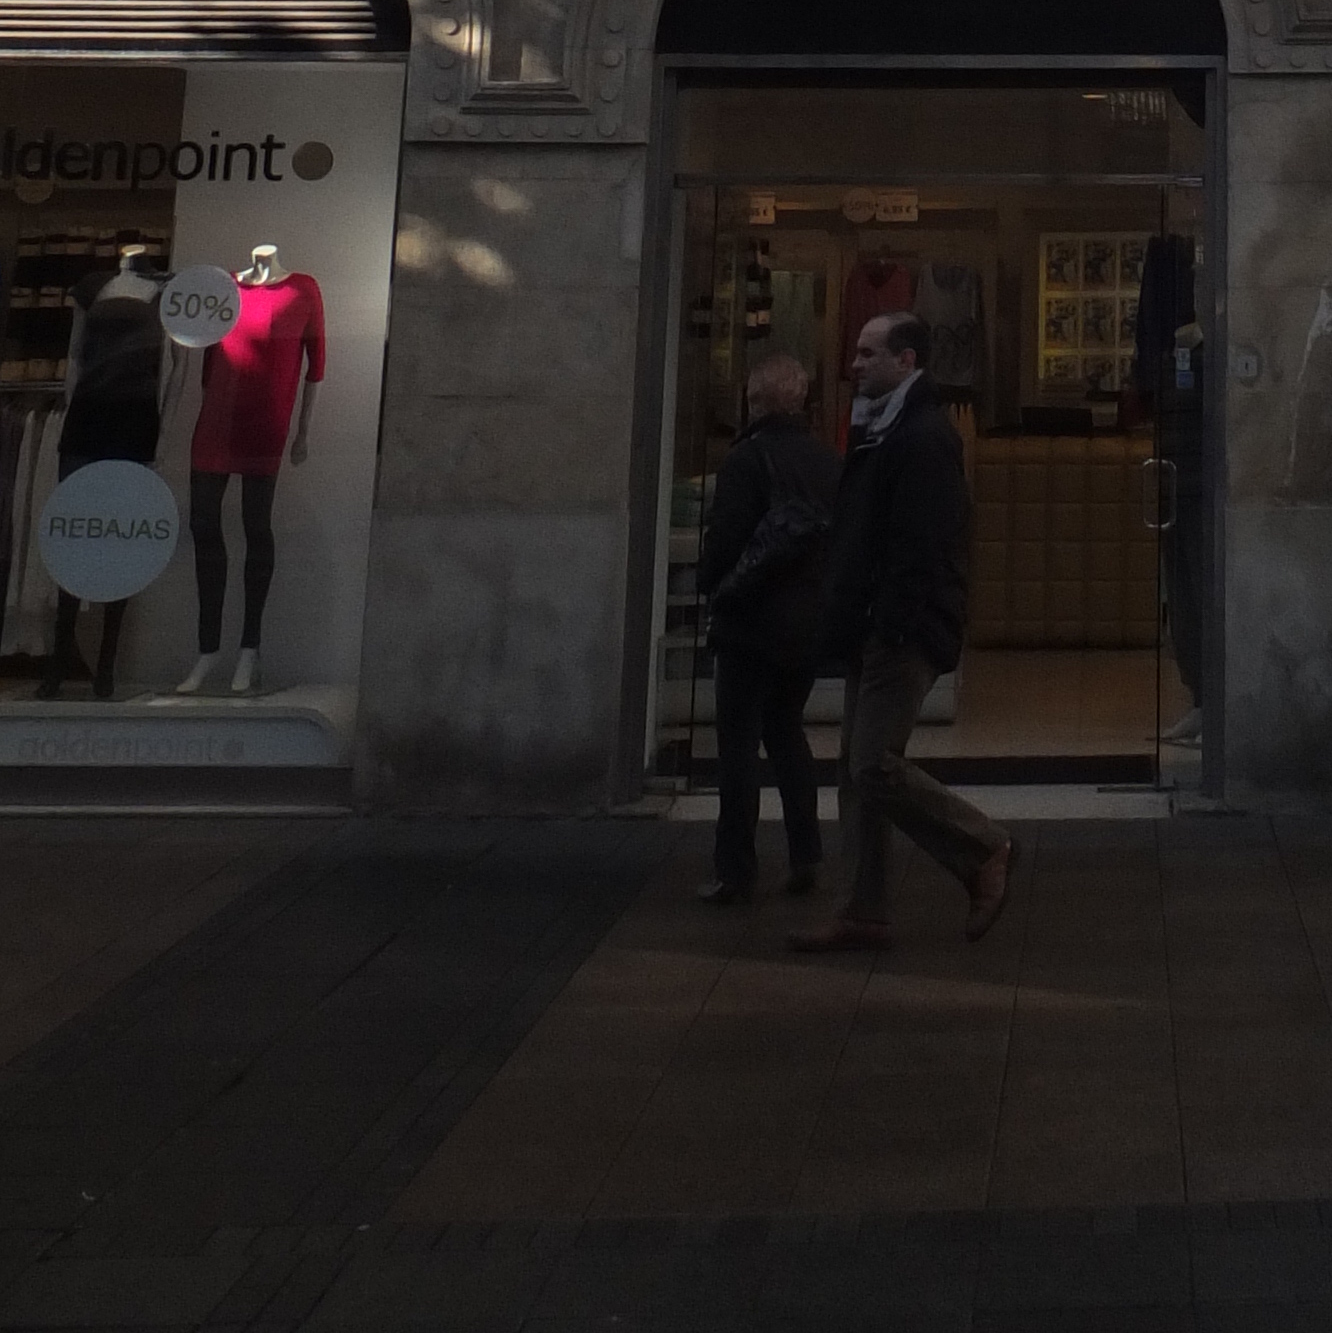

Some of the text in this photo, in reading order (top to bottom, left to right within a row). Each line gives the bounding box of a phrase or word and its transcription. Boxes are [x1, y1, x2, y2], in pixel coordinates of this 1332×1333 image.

[0, 125, 286, 191] ldenpoint
[167, 291, 234, 322] 50%
[49, 517, 171, 540] REBAJAS
